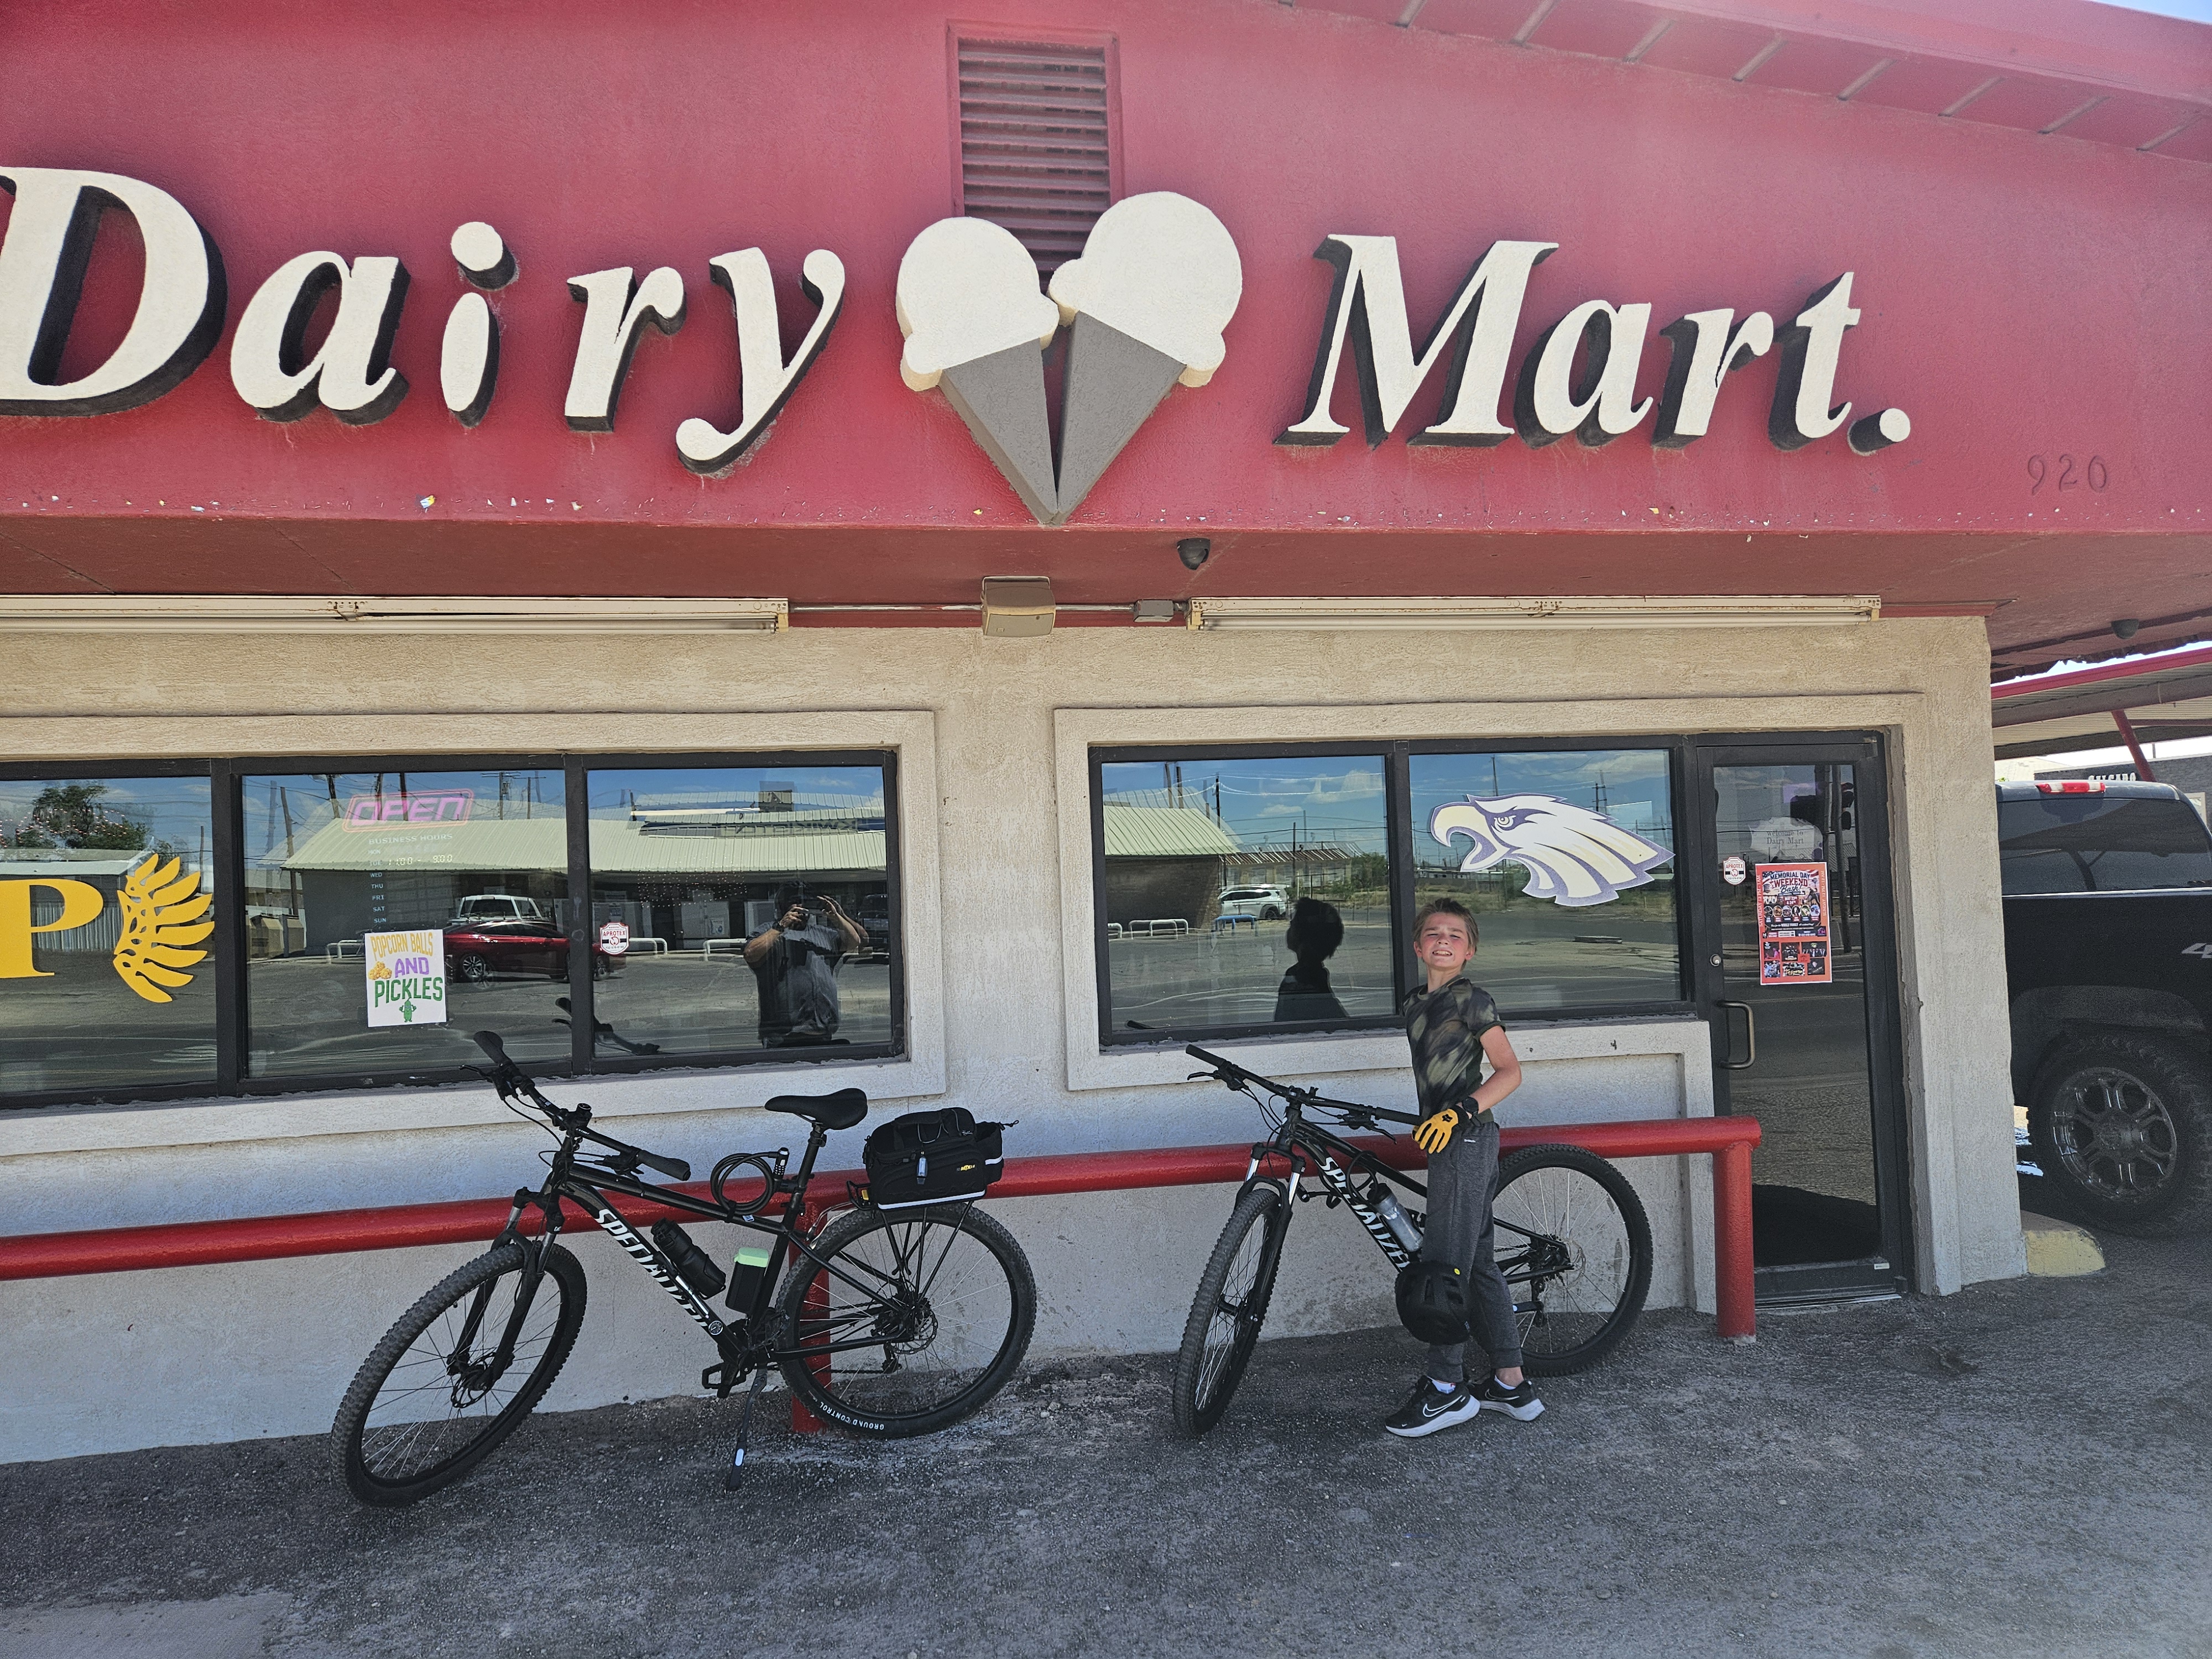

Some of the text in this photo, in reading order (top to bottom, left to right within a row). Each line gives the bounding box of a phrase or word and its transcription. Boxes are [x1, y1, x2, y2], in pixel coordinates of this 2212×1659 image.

[0, 167, 1911, 471] Dairy Mart.
[2028, 453, 2107, 495] 920
[351, 797, 465, 826] OPEN
[368, 836, 417, 845] BUSINESS
[1770, 872, 1798, 880] MEMORIAL
[1773, 878, 1808, 888] WEEKEND
[1780, 883, 1803, 893] Bash!
[370, 932, 434, 961] POPCORN BALLS
[395, 957, 430, 978] AND
[374, 977, 444, 1008] PICKLES
[820, 1401, 884, 1430] GROUND CONTROL
